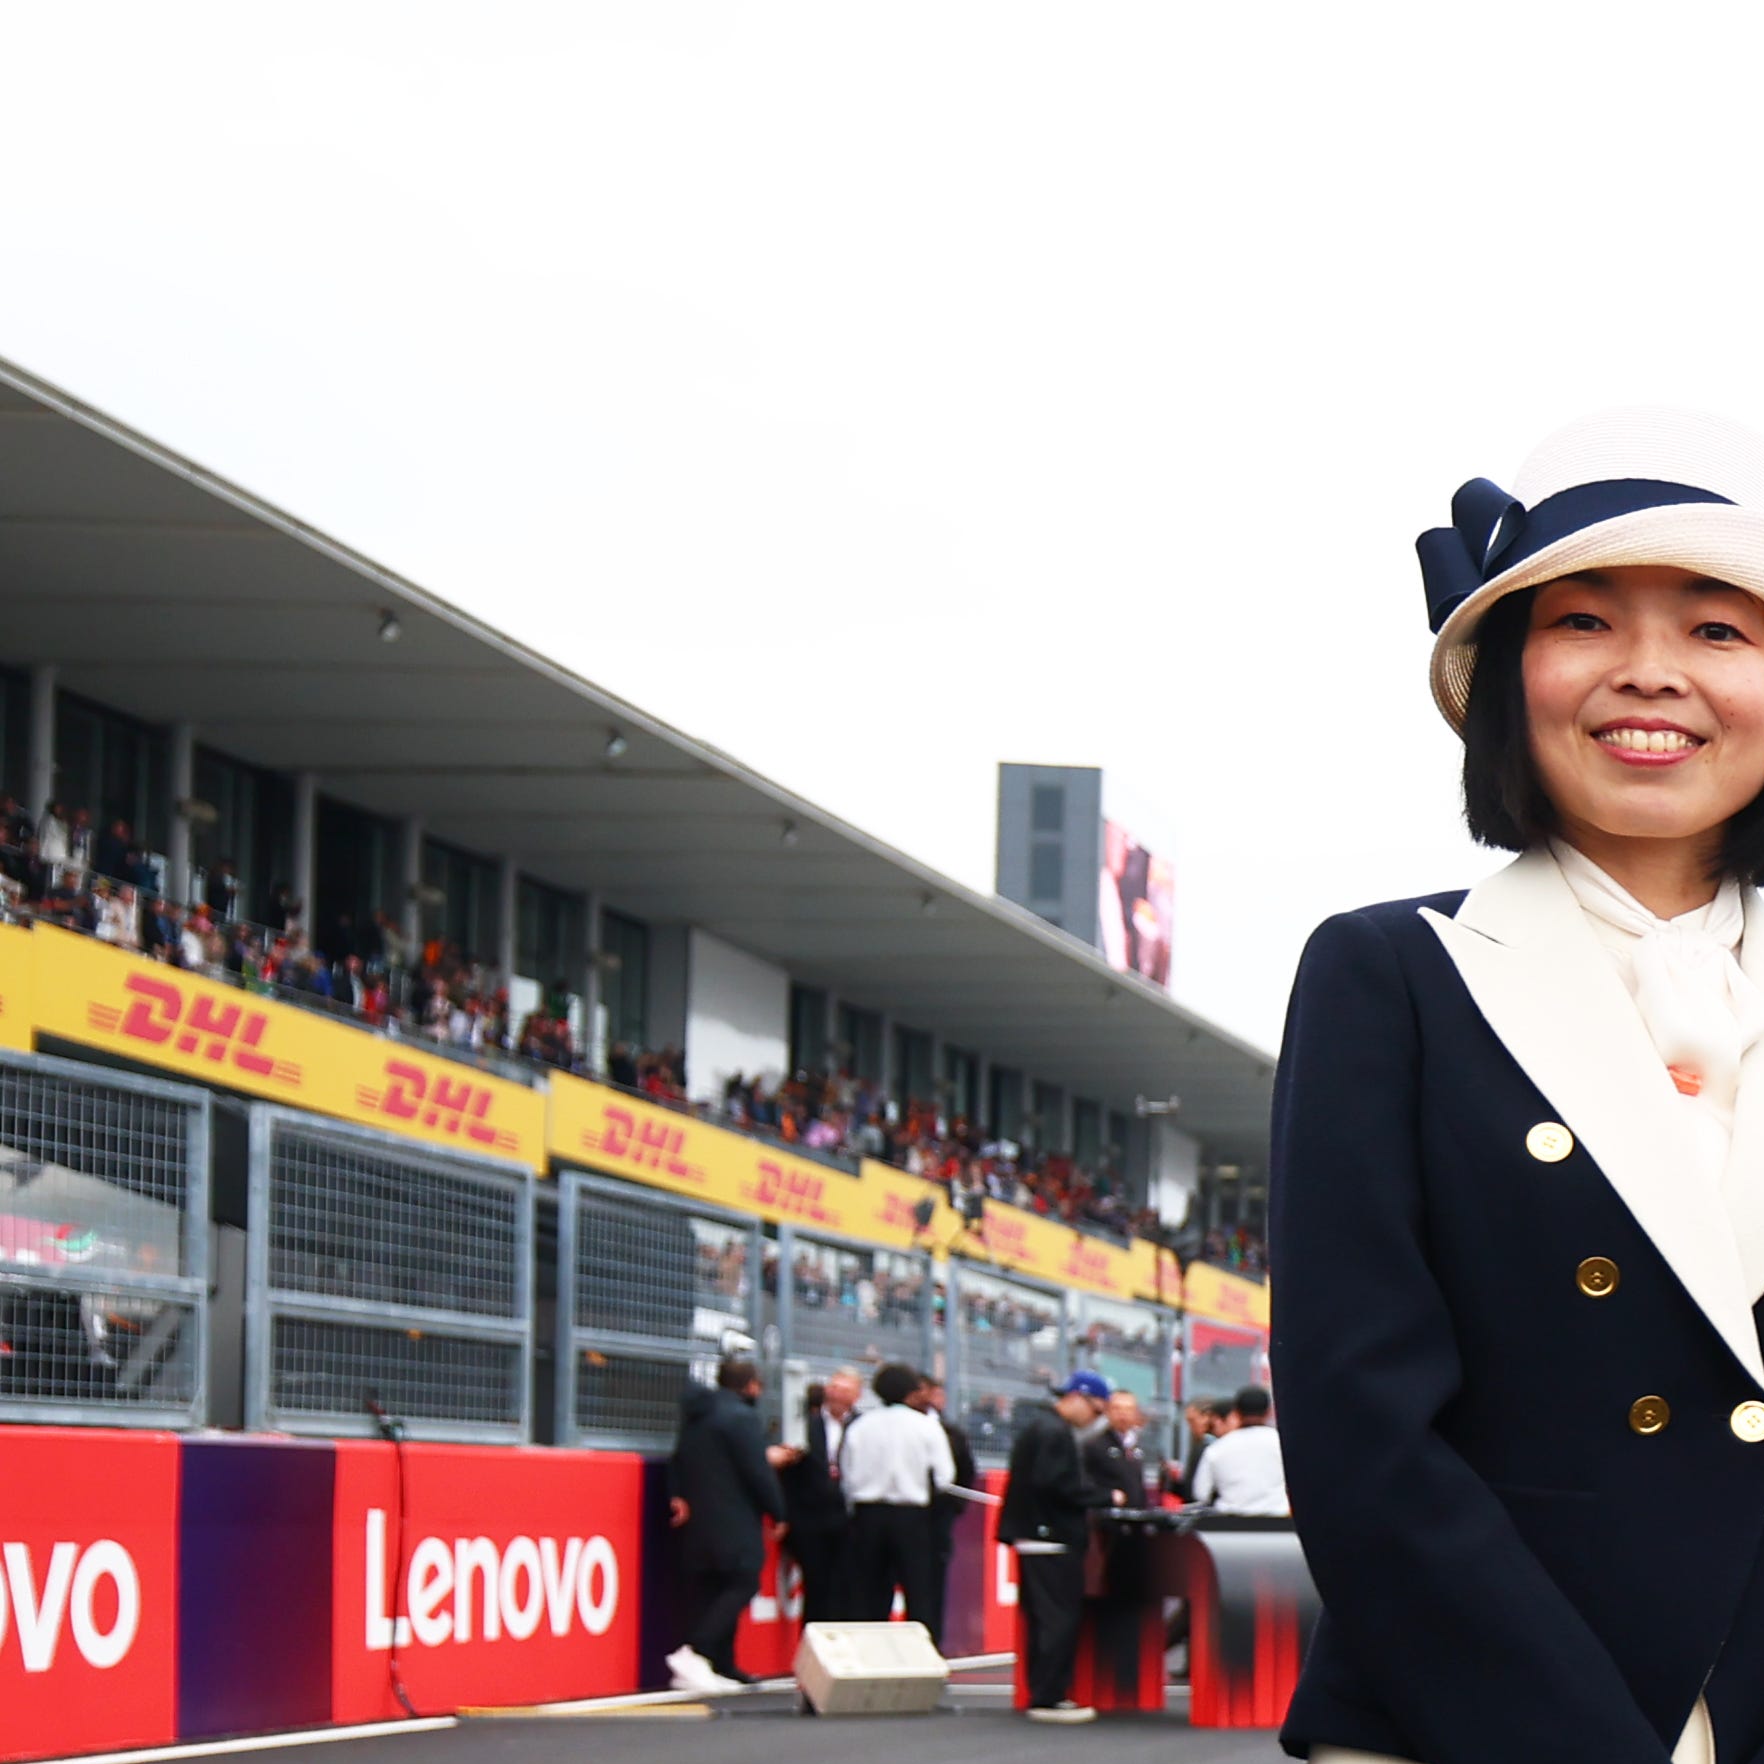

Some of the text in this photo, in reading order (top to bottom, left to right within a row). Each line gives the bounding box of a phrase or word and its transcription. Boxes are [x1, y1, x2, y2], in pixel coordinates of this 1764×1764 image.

[120, 972, 275, 1077] DHL
[380, 1058, 498, 1145] DHL
[601, 1104, 689, 1178] DHL
[0, 1539, 141, 1673] vo
[365, 1508, 619, 1650] Lenovo
